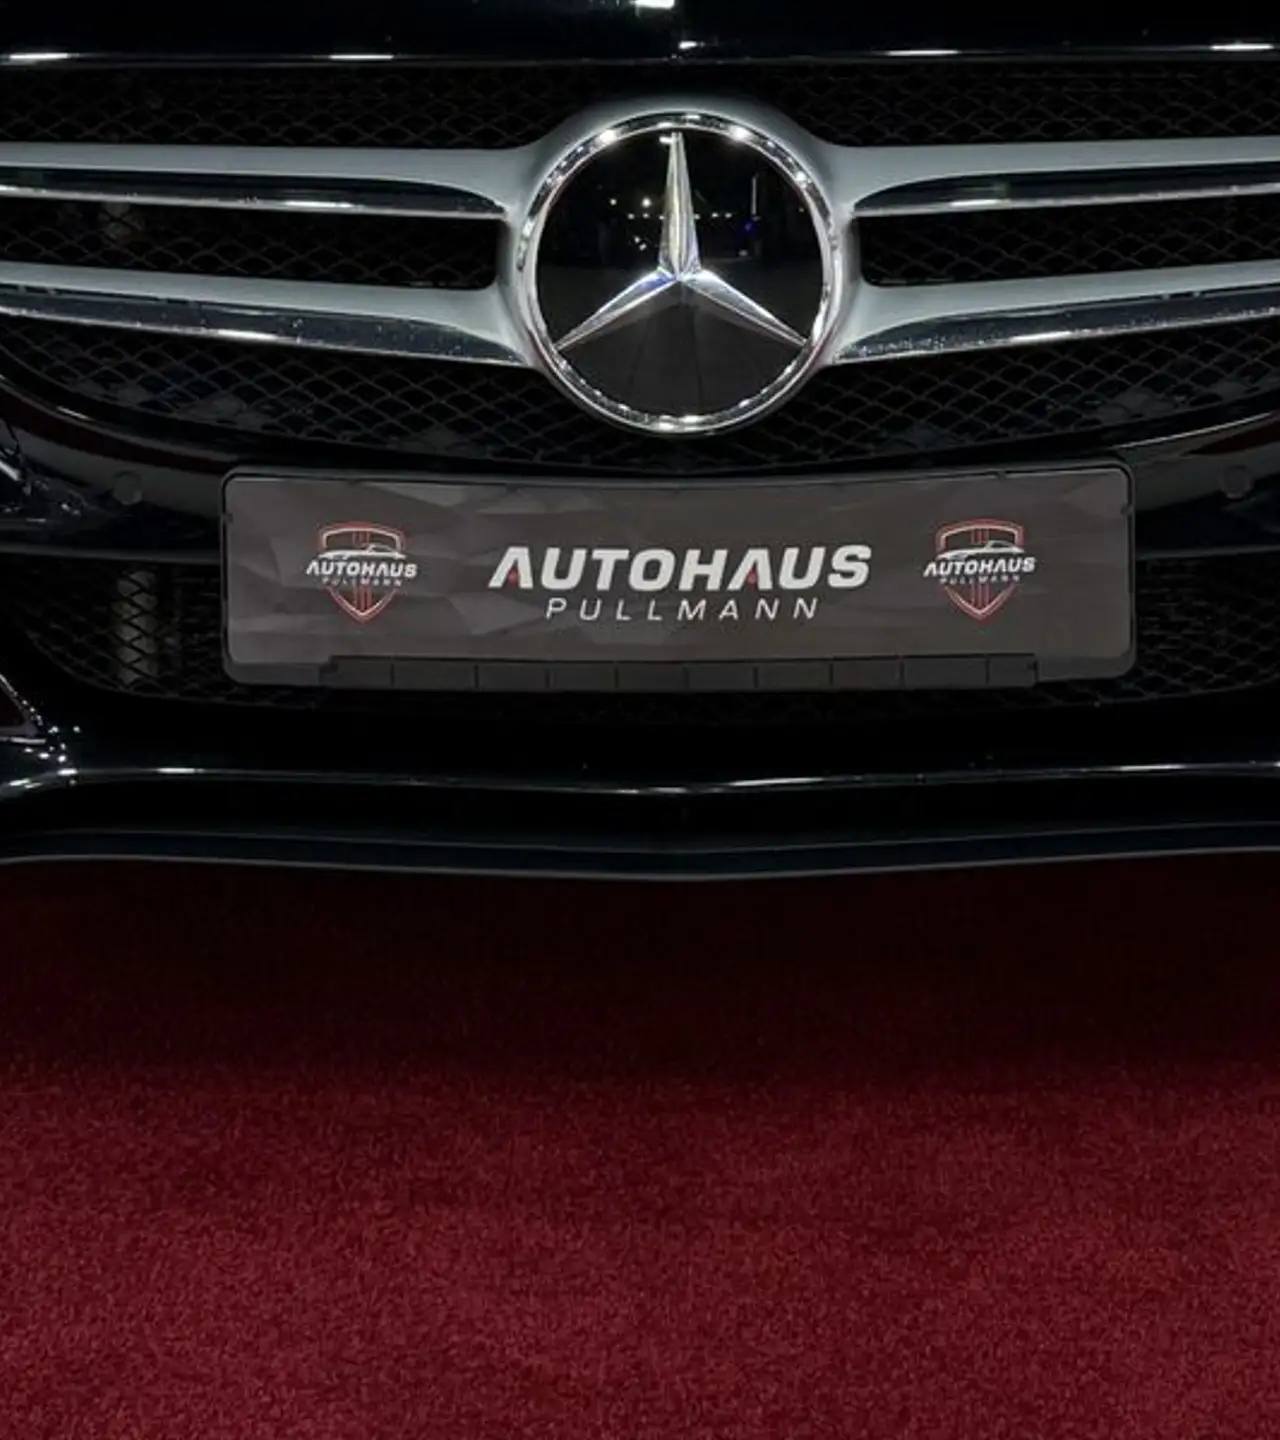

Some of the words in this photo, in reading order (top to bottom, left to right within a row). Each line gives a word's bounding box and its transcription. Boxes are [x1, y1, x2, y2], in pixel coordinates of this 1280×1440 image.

[305, 560, 418, 578] AUTOHAUS
[487, 545, 872, 592] AUTOHAUS
[922, 556, 1036, 578] AUTOHAUS
[545, 596, 818, 622] PULLMANN
